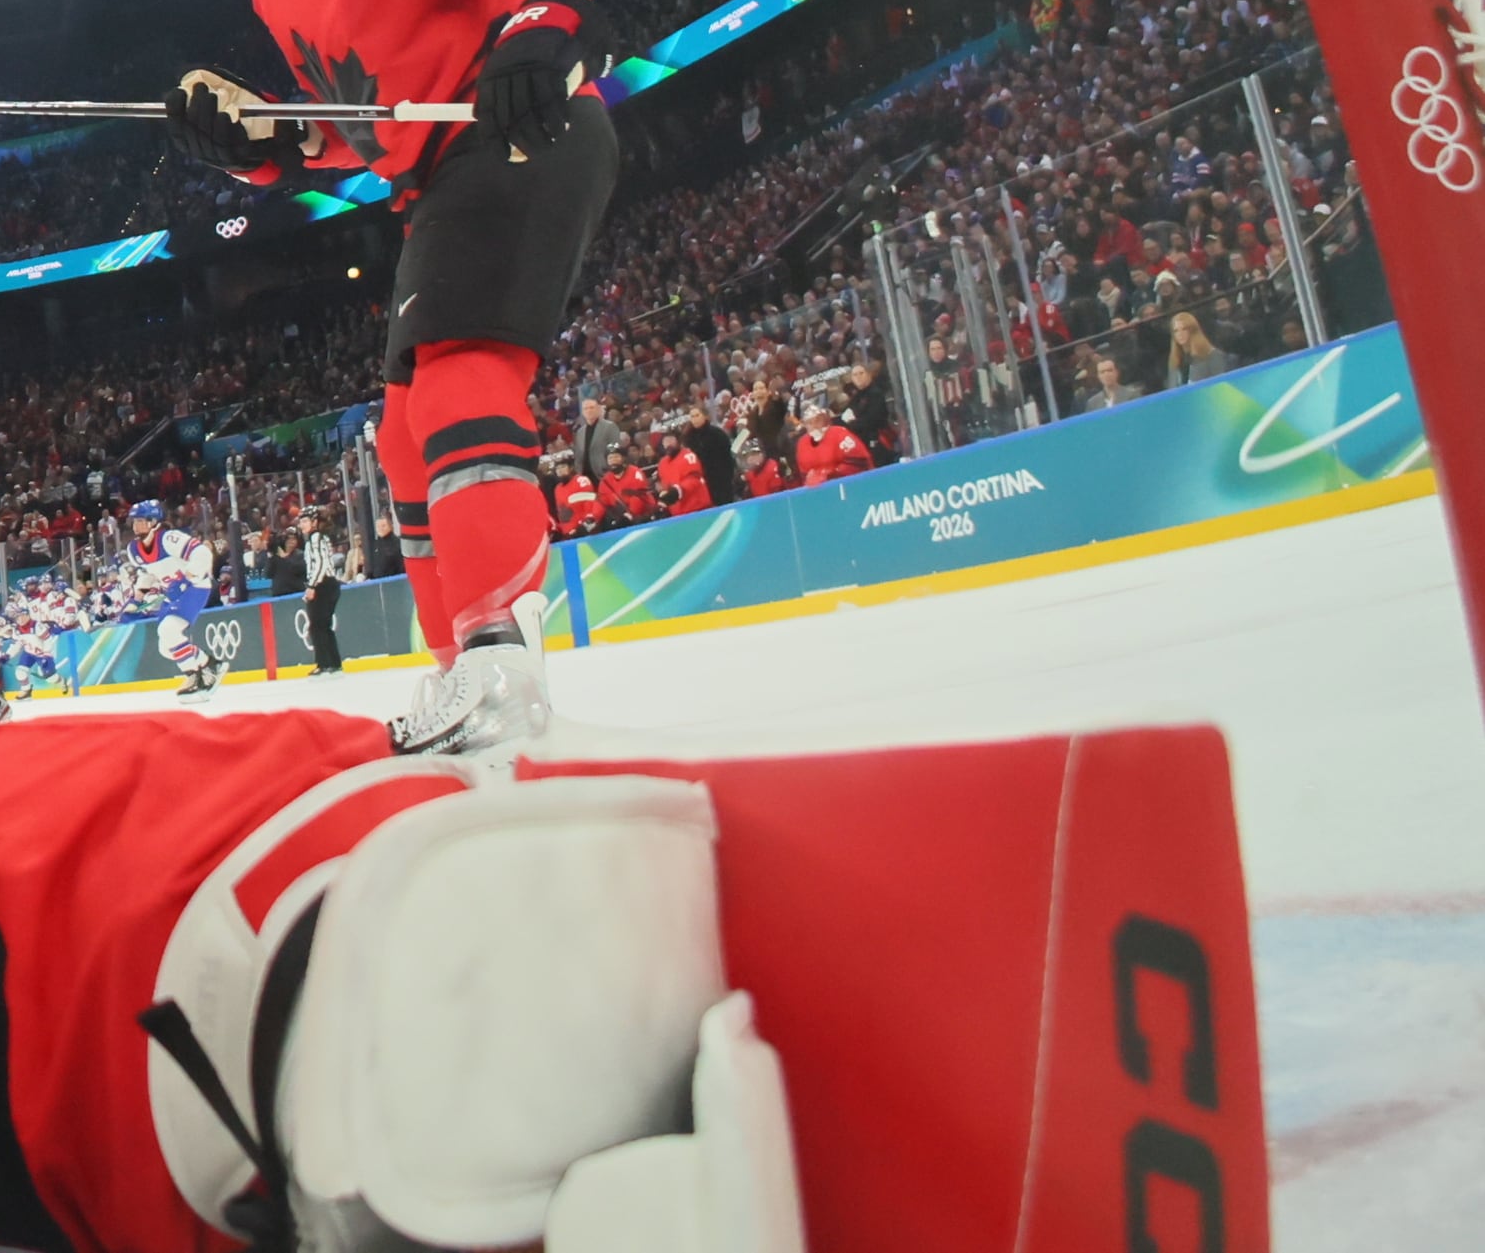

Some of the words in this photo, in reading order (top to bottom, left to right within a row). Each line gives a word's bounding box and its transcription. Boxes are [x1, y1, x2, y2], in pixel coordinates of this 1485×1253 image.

[860, 489, 946, 529] MILANO
[946, 468, 1045, 510] CORTINA
[929, 511, 975, 542] 2026
